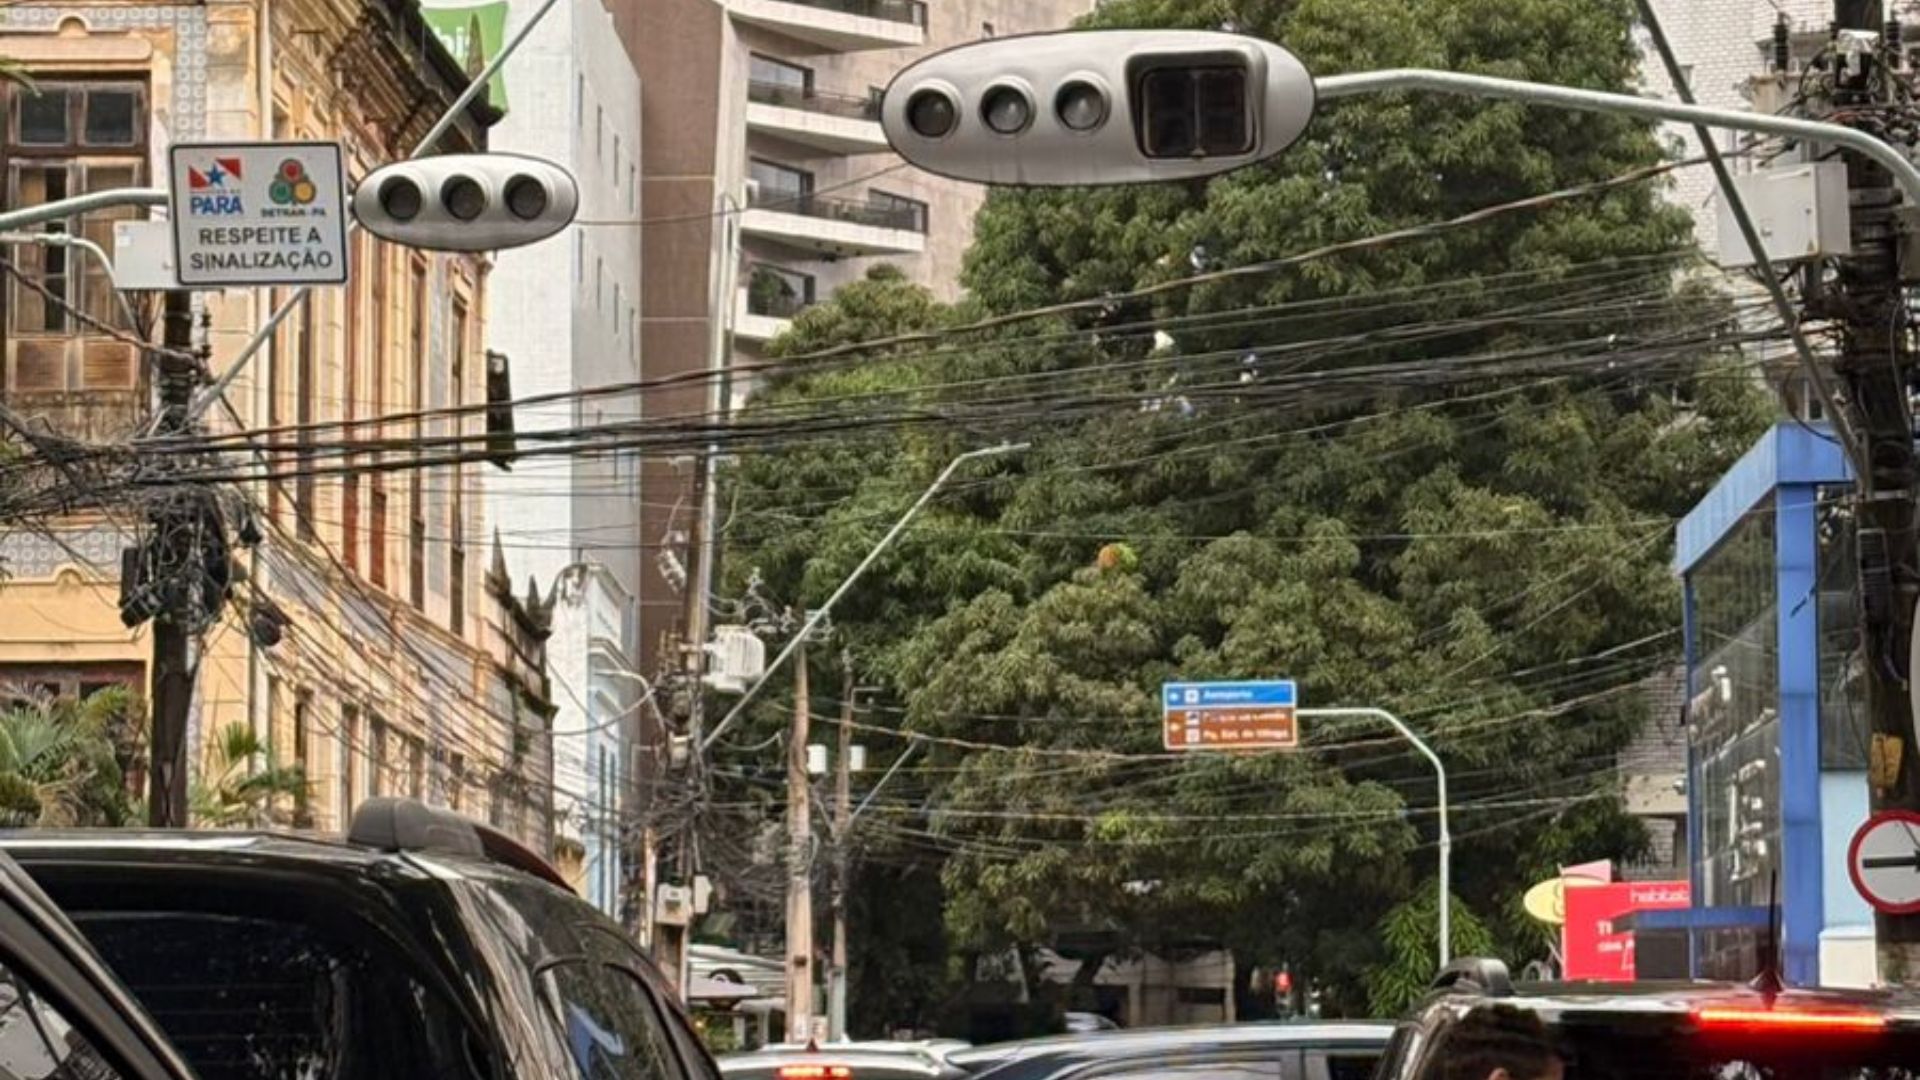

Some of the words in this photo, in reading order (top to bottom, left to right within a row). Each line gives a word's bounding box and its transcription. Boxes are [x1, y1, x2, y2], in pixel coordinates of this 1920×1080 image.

[199, 227, 301, 245] RESPEITE
[307, 227, 322, 244] A
[190, 248, 333, 271] SINALIZAÇÃO
